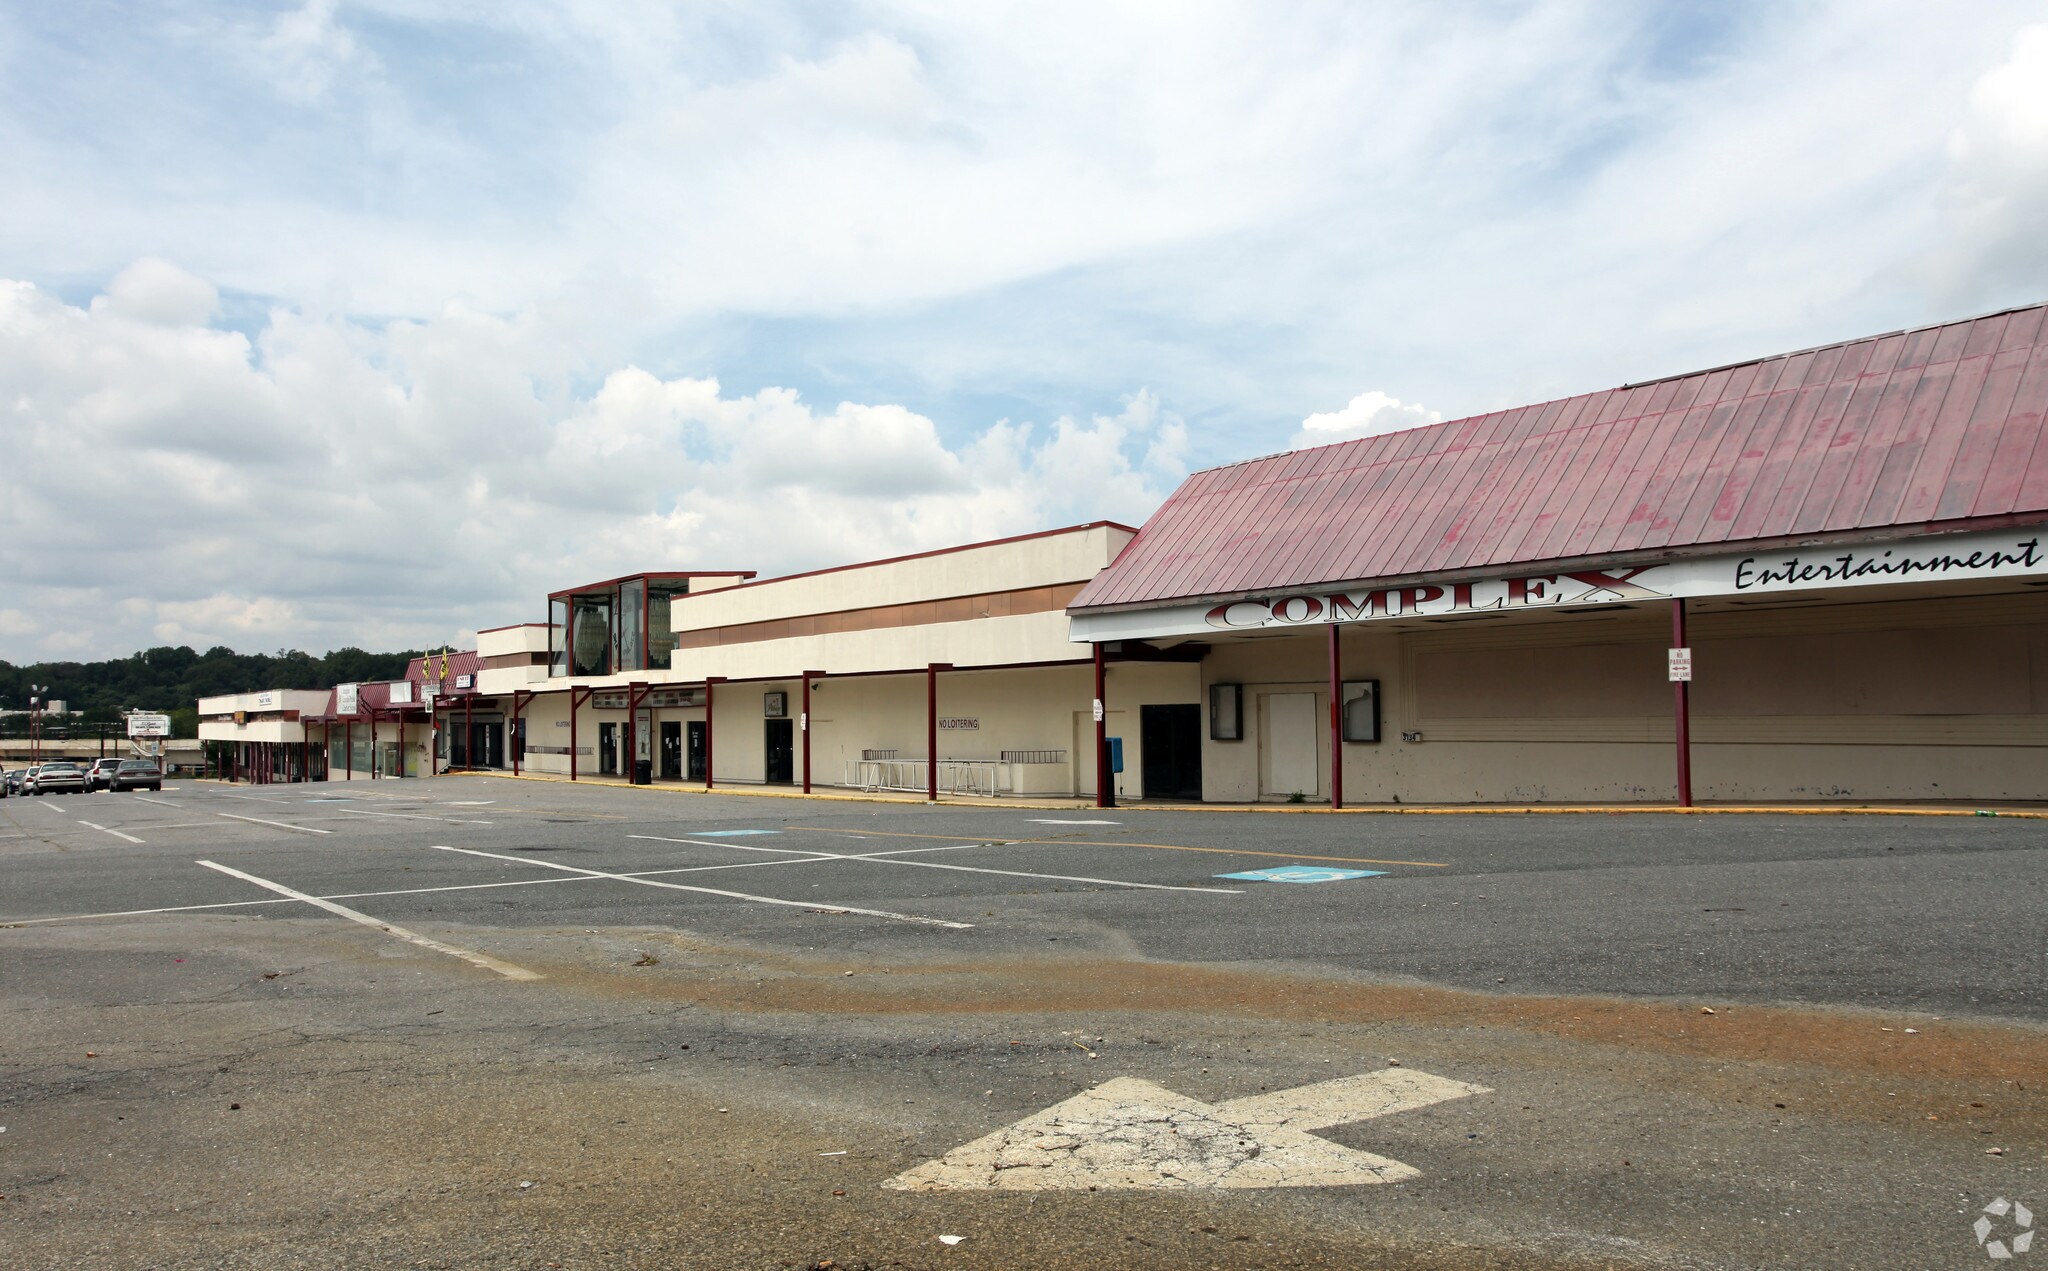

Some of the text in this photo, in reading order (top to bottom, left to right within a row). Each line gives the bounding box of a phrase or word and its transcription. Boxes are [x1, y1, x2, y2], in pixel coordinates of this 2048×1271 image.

[1735, 538, 2044, 590] Entertainment
[939, 719, 978, 729] NO LOITERING
